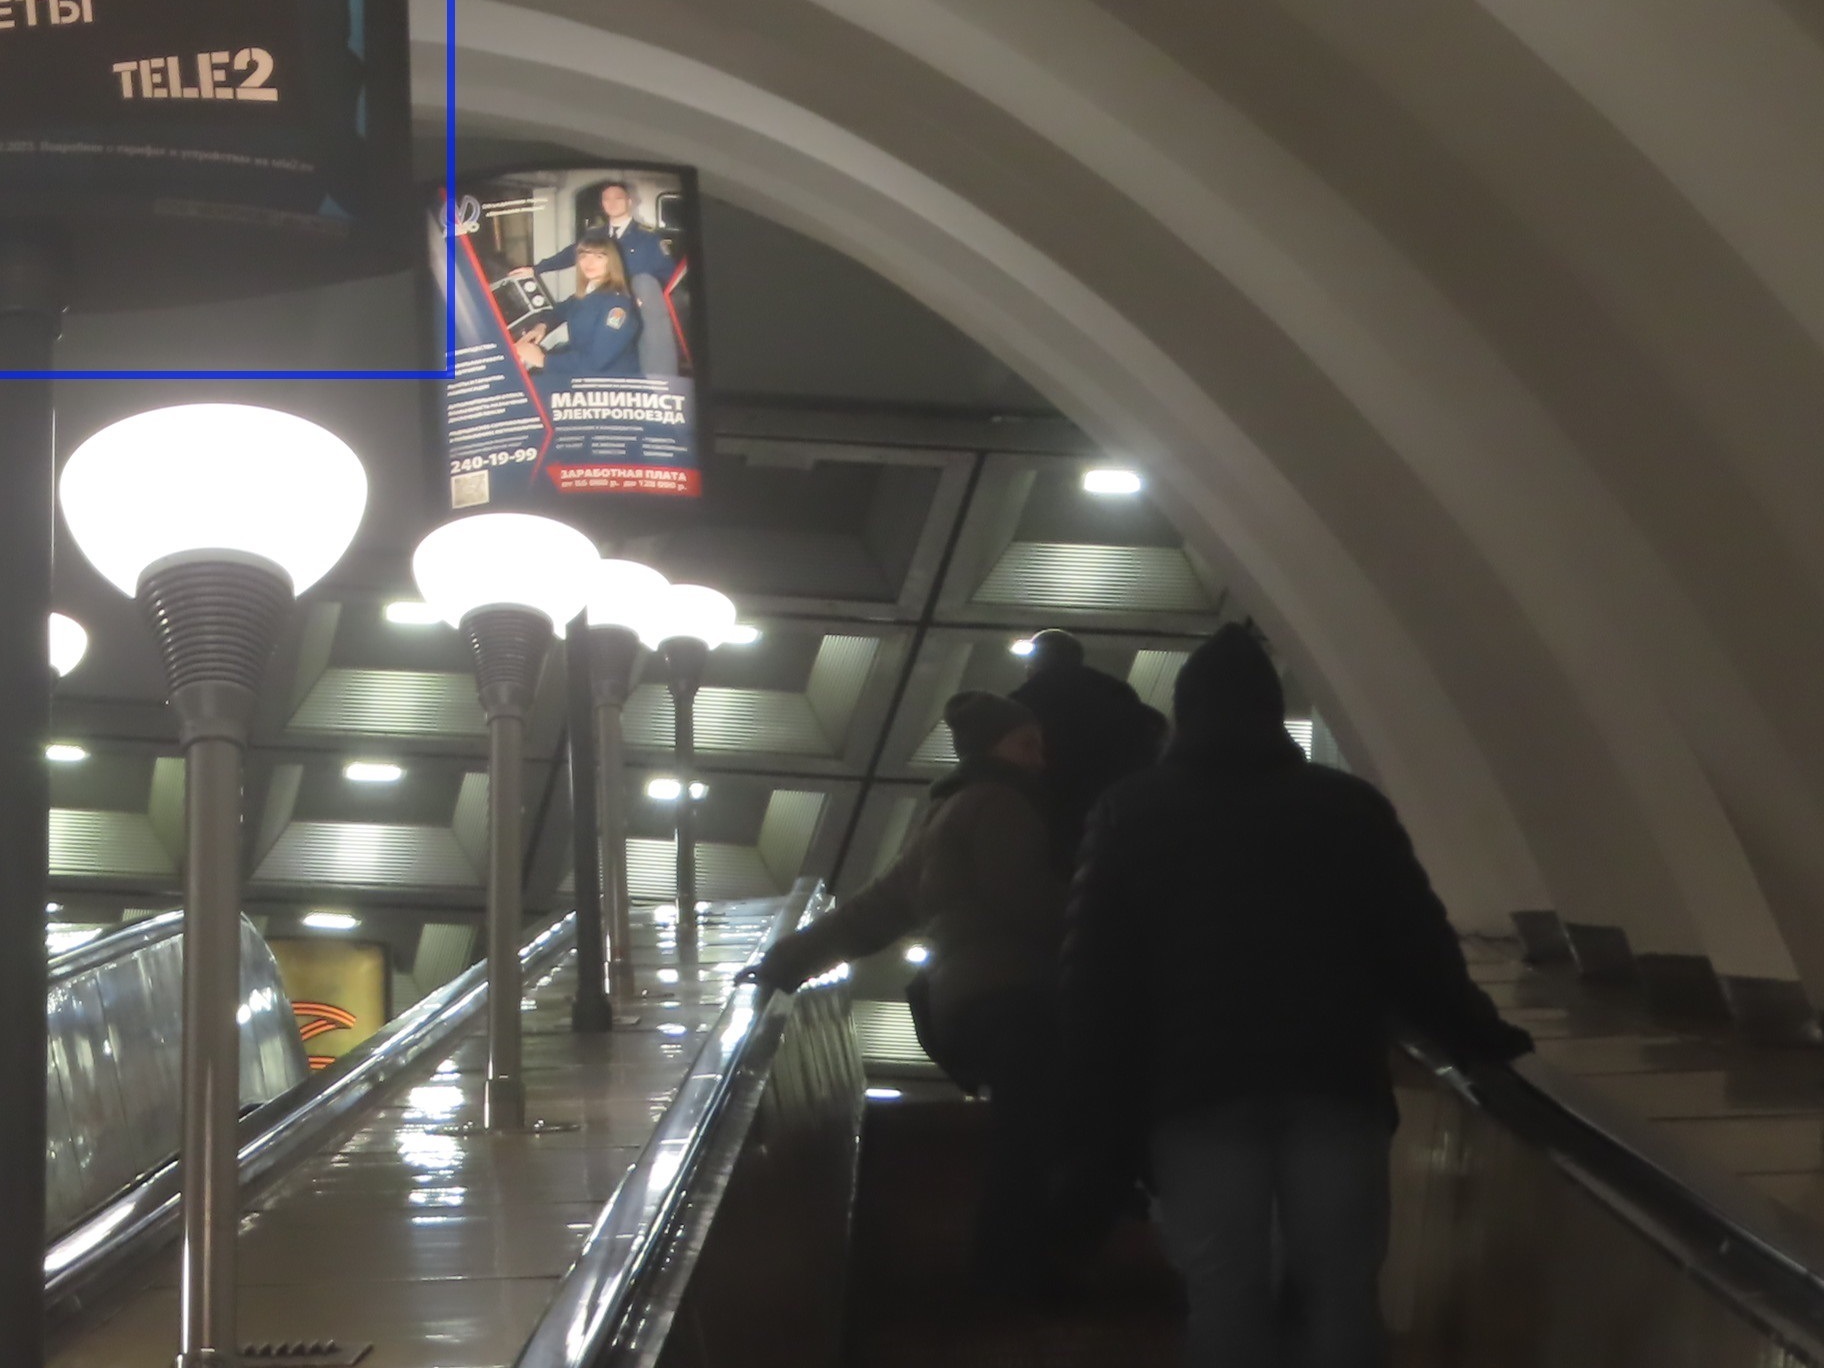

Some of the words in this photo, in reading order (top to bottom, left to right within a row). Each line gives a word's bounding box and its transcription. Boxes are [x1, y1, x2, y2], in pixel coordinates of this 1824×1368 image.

[112, 47, 279, 101] TELE2
[551, 391, 685, 410] МАШИНИСТ
[552, 408, 686, 424] ЭЛЕКТРОПОЕЗДА
[450, 447, 537, 474] 240-19-99
[561, 469, 643, 479] ЗАРАБОТНАЯ
[645, 470, 687, 482] ПЛАТА
